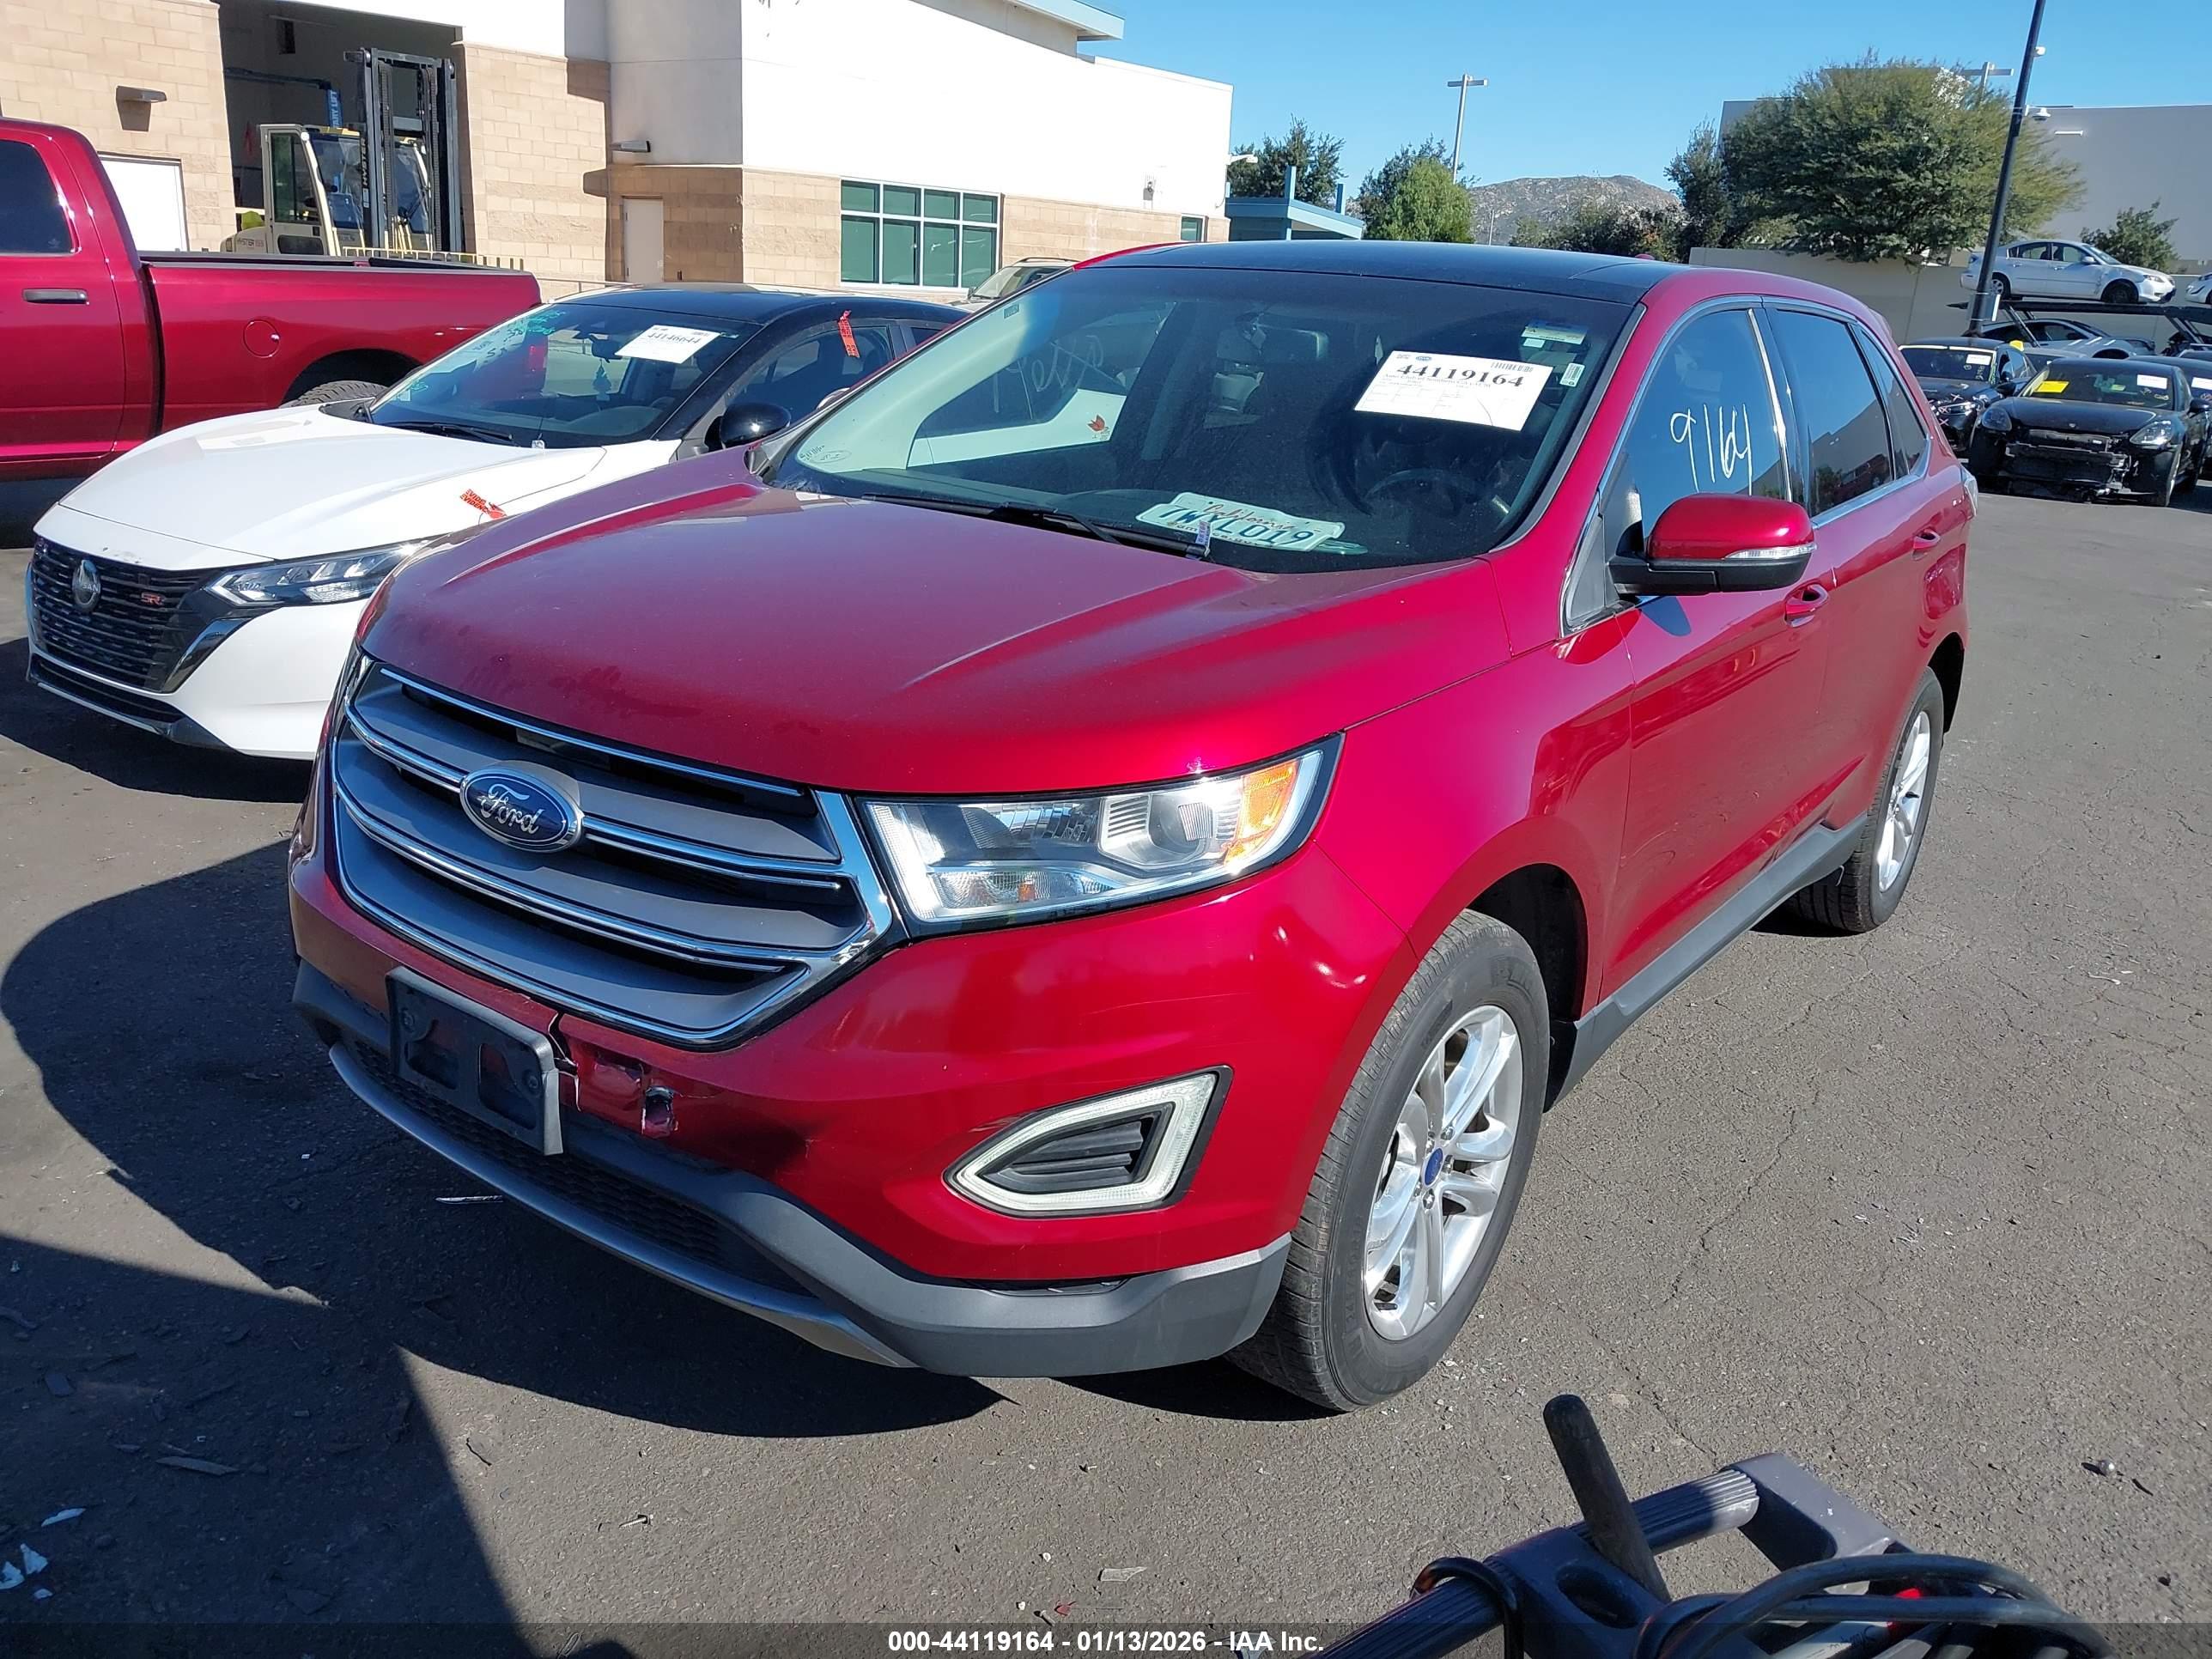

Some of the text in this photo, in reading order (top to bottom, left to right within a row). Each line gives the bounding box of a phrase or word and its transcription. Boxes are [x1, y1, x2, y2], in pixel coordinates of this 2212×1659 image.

[1397, 365, 1524, 387] 44119164
[1670, 404, 1753, 496] 9164
[1158, 505, 1314, 545] 7WYL019
[1202, 504, 1294, 530] California
[478, 783, 544, 835] Ford
